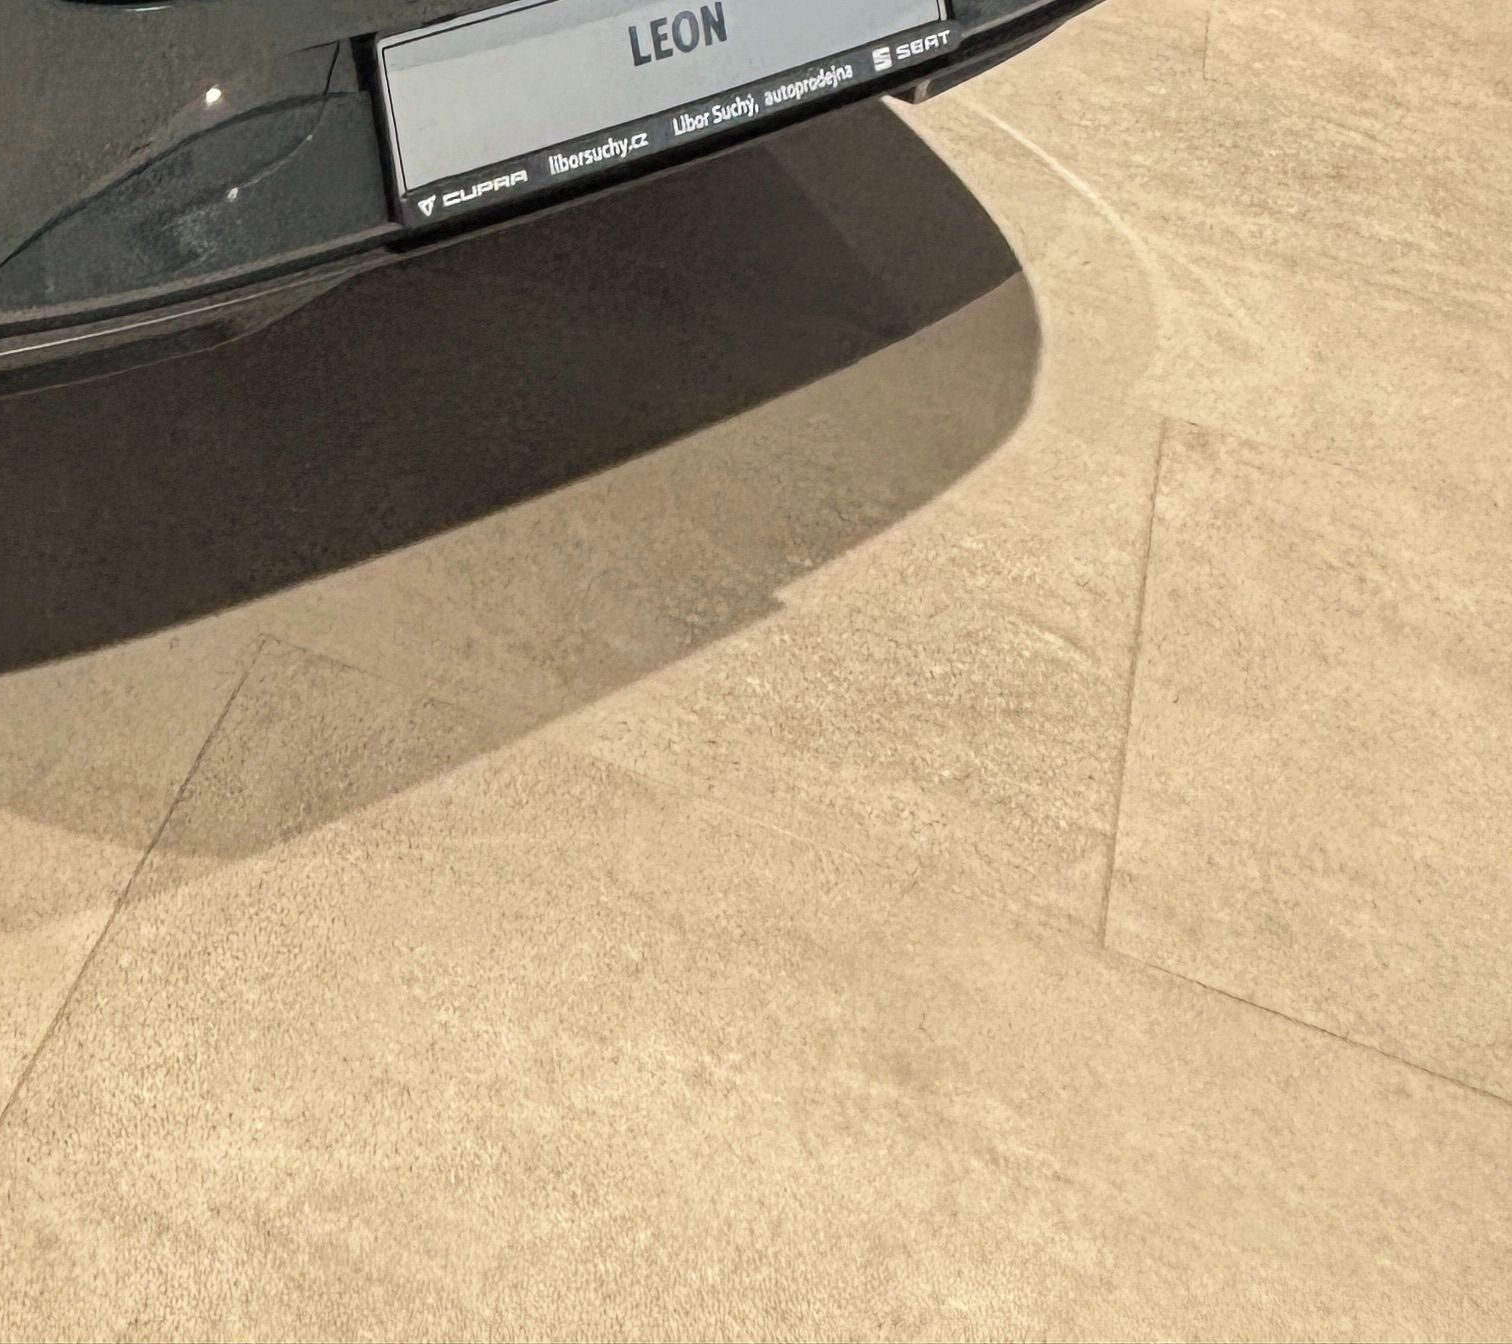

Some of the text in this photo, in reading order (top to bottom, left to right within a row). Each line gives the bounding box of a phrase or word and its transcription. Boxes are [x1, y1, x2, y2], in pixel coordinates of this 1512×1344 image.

[628, 1, 727, 67] LEON
[895, 29, 951, 61] SEAT
[763, 62, 854, 107] autoprodejna
[548, 131, 650, 176] liborsuchy.cz
[441, 168, 529, 208] CUPRA
